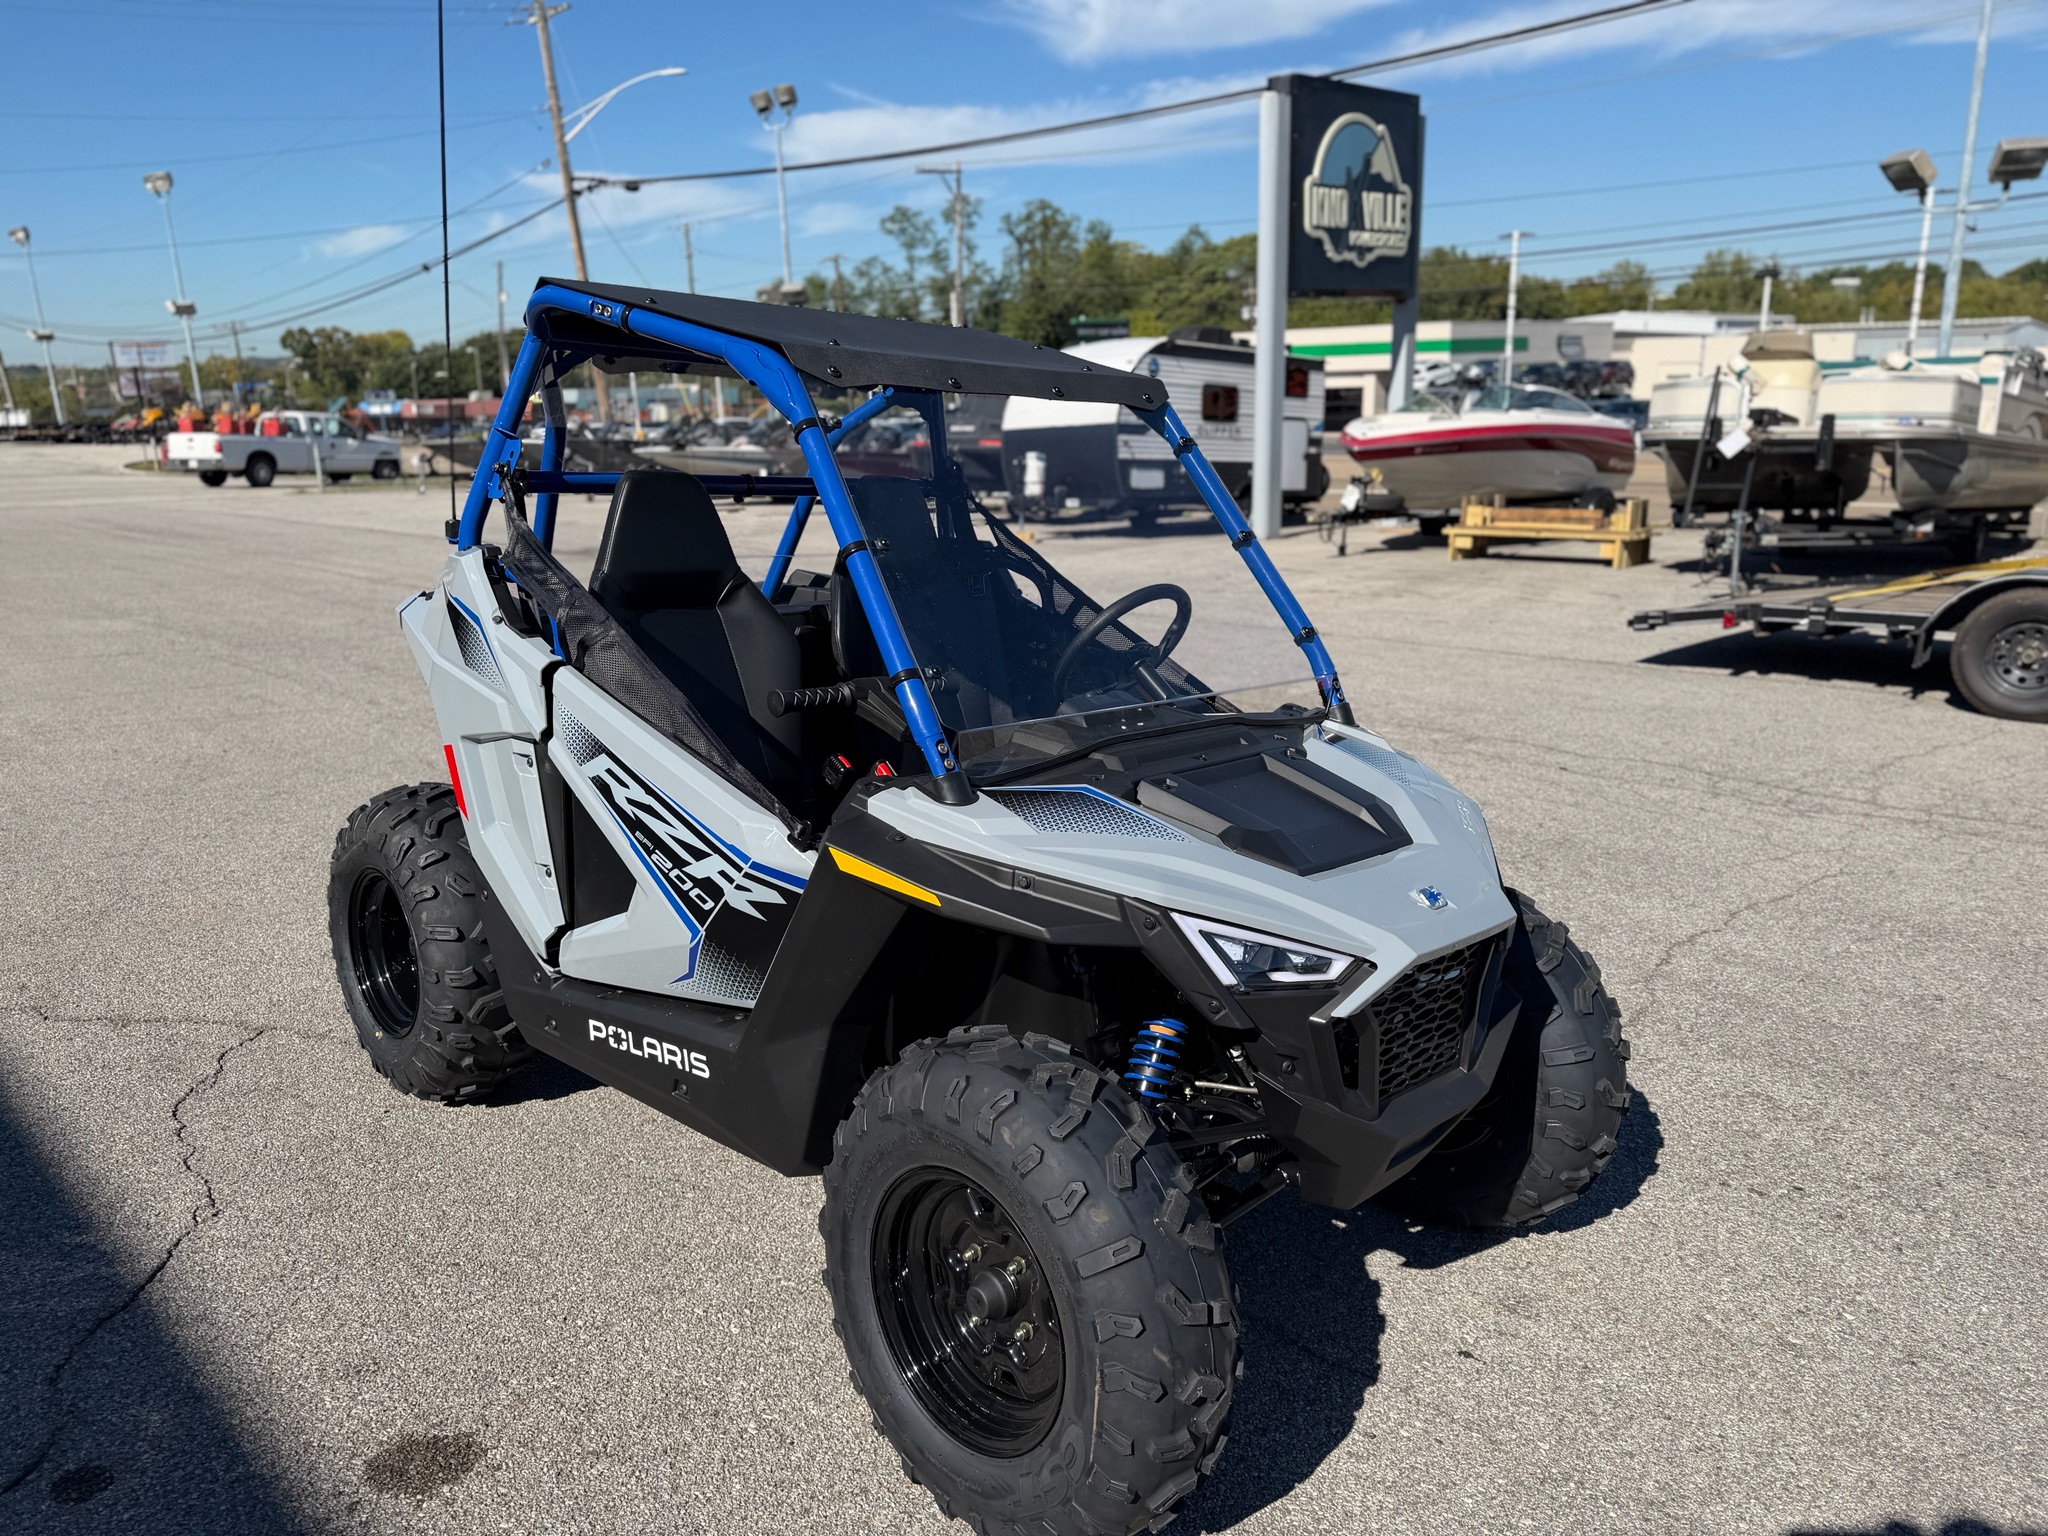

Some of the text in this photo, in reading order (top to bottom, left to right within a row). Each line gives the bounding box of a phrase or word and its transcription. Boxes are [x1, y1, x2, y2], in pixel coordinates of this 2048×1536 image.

[583, 753, 788, 922] RZR
[634, 830, 715, 912] EFI 200
[588, 1018, 711, 1079] POLARIS
